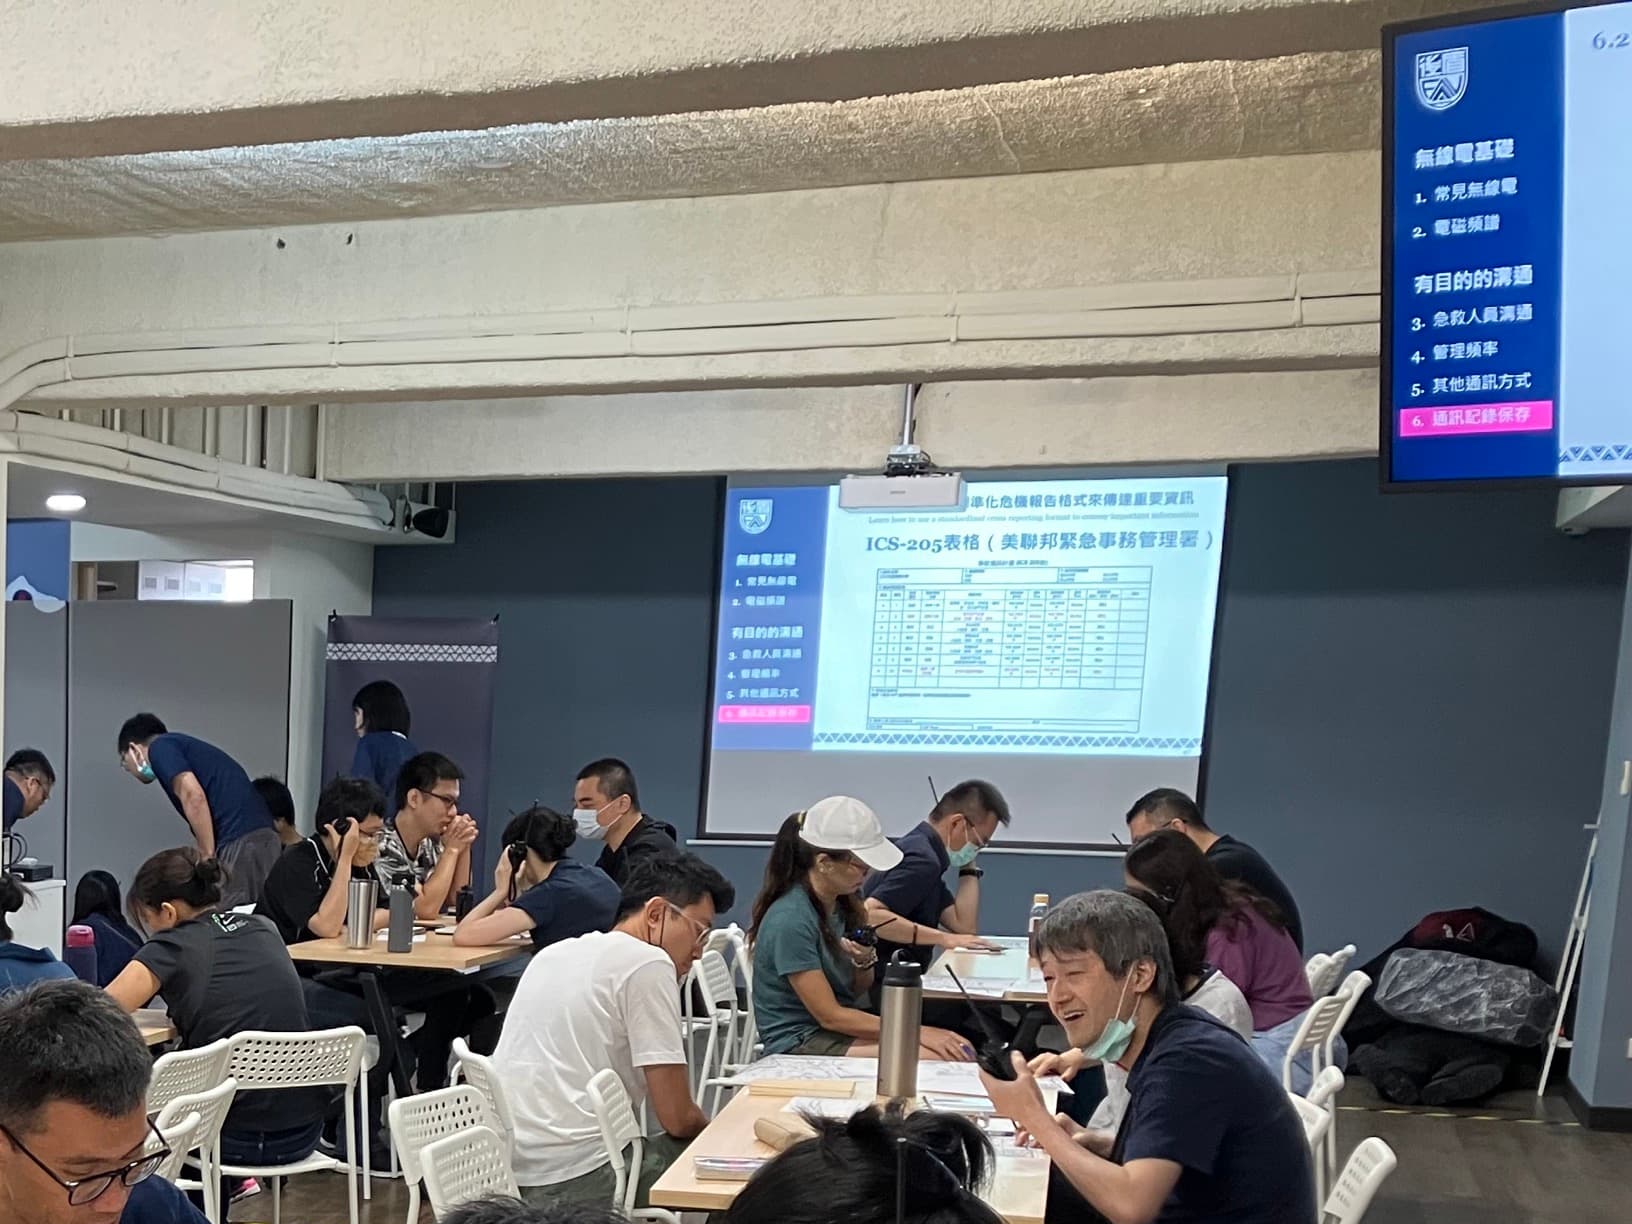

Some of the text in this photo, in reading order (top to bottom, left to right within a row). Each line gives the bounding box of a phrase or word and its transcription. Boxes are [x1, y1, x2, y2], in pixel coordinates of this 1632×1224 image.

[1415, 138, 1514, 169] 無線電基礎
[1434, 177, 1518, 201] 常見無線電
[1414, 265, 1533, 294] 有目的的溝通
[1433, 304, 1533, 327] 急救人員溝通
[1433, 341, 1498, 360] 管理頻率
[1432, 372, 1532, 393] 其他通訊方式
[967, 491, 1194, 508] 準化危機報告格式來傳達重要資訊
